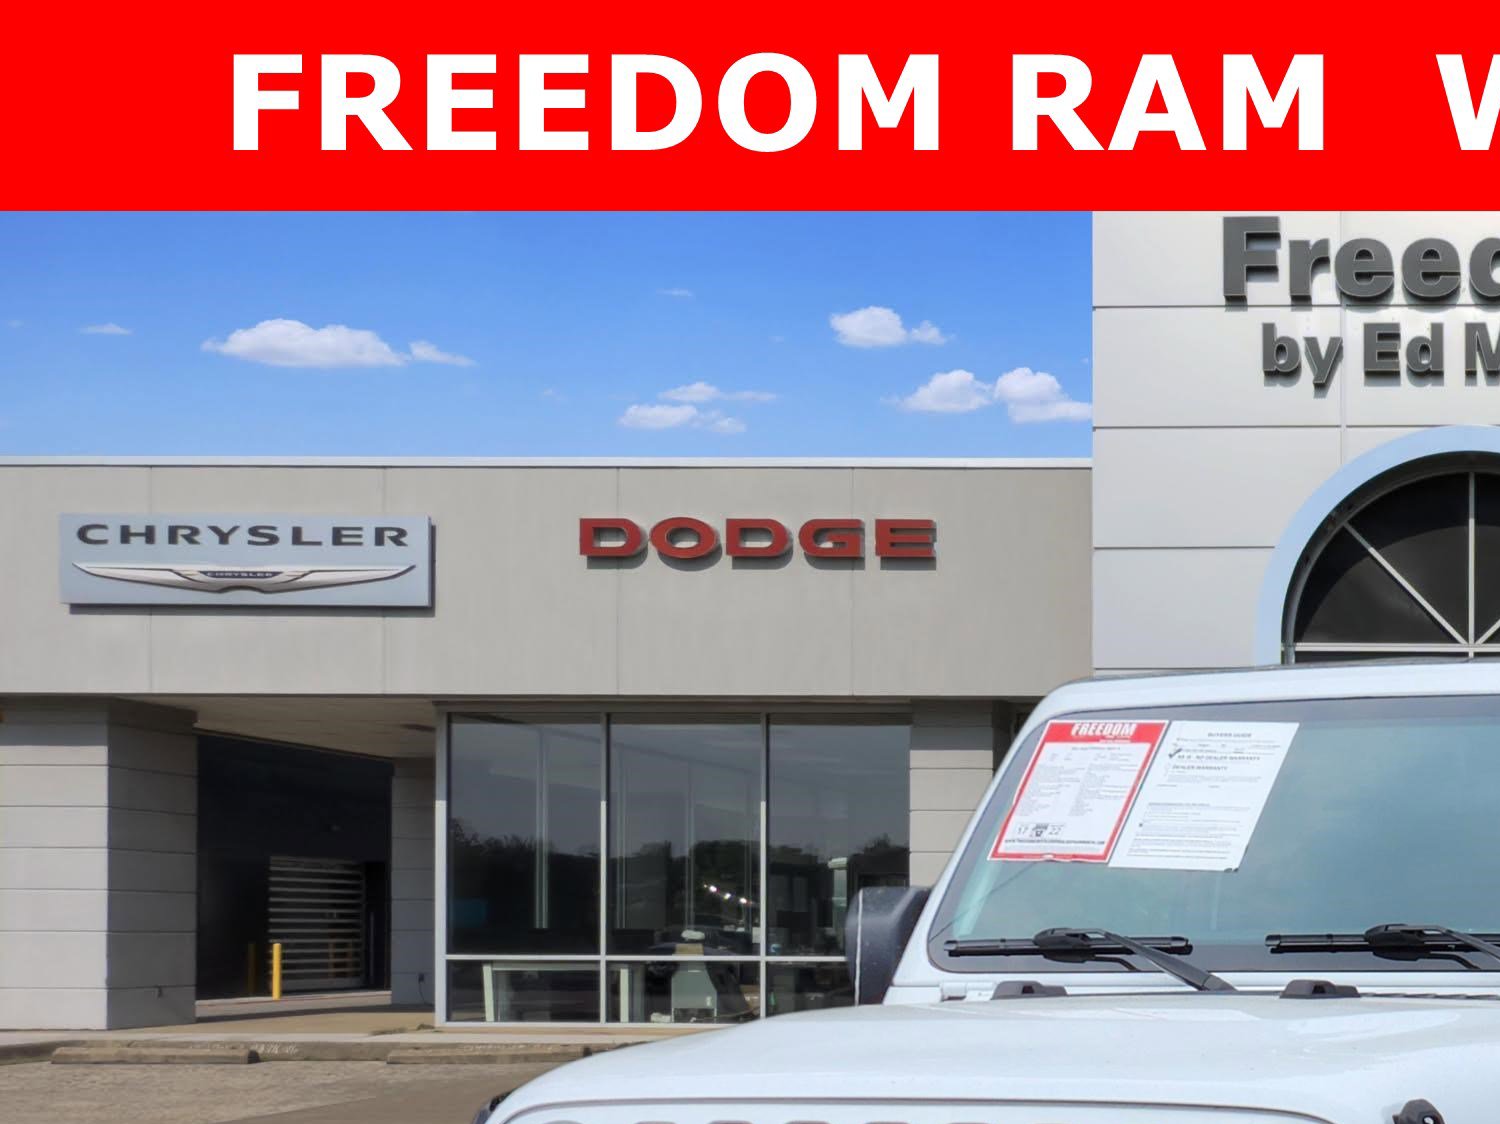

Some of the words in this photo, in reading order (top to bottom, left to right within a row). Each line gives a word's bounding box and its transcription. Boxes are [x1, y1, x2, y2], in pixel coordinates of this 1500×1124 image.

[1261, 321, 1343, 384] by
[1363, 321, 1444, 376] Ed
[76, 524, 408, 547] CHRYSLER
[578, 517, 935, 559] DODGE
[205, 571, 273, 579] CHRYSLER
[1071, 722, 1138, 737] FREEDOM
